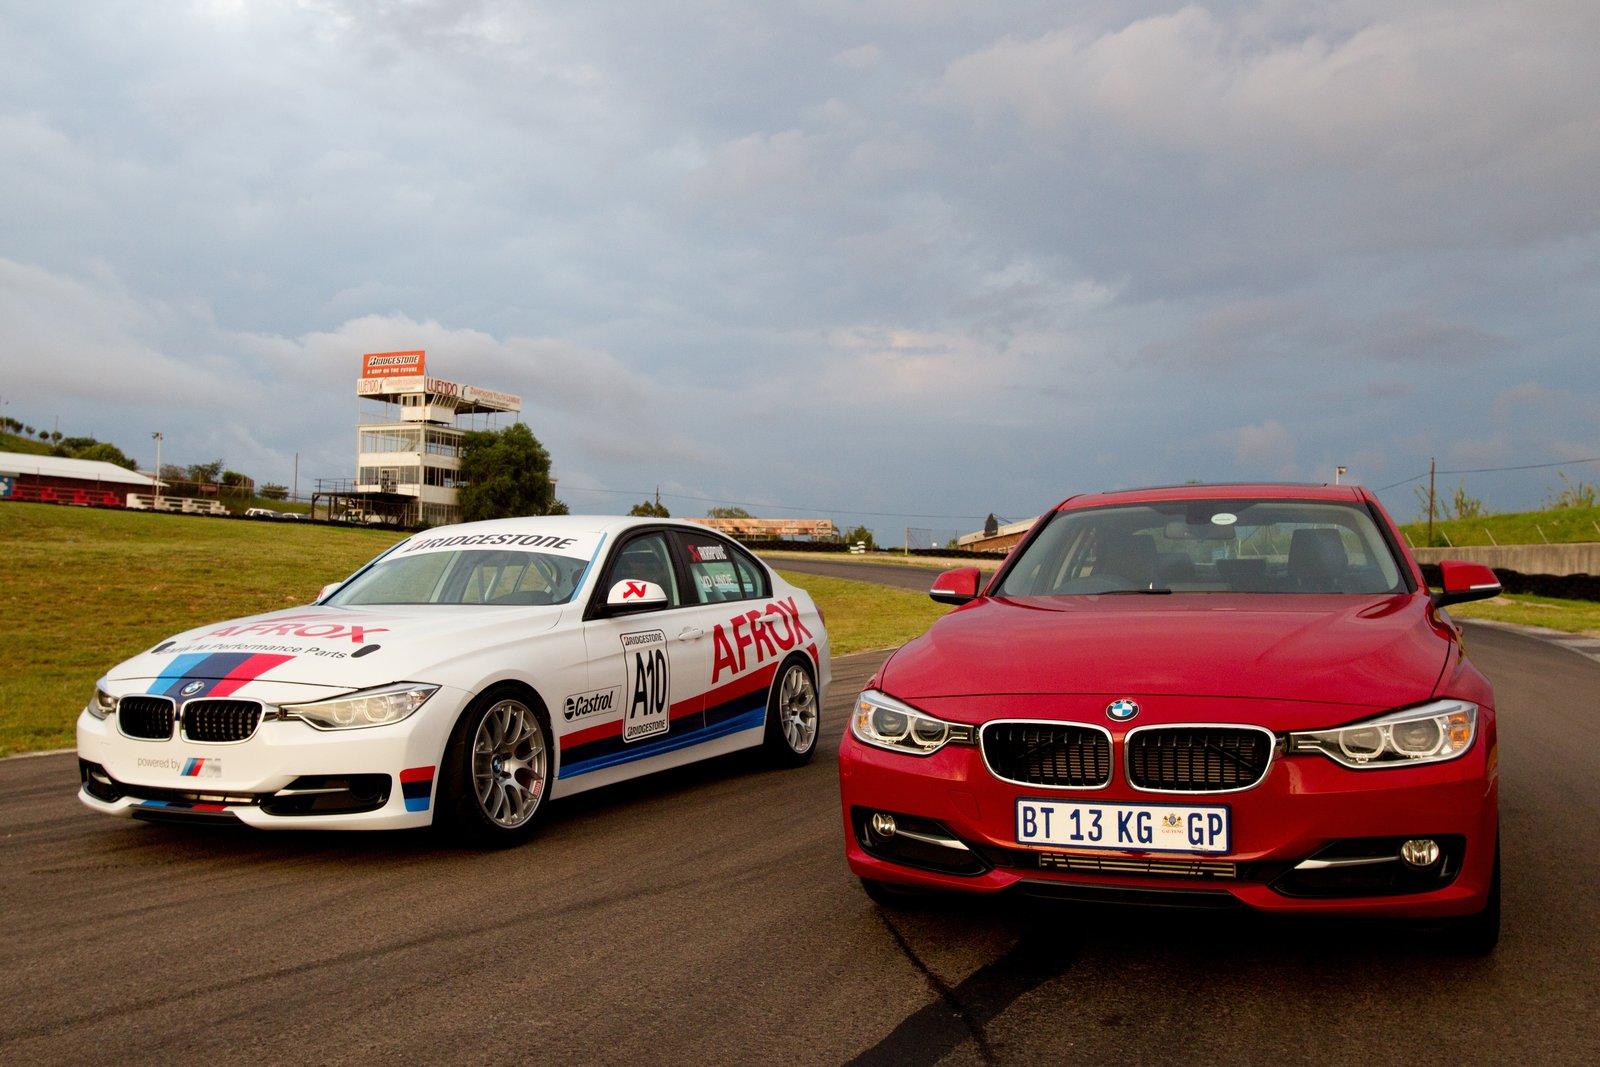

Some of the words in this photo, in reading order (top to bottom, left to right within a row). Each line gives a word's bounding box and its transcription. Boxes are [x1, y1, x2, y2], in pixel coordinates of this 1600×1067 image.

[369, 356, 418, 366] BRIDGESTONE
[408, 534, 578, 551] BRIDGESTONE
[193, 622, 391, 643] AFROX
[624, 633, 663, 646] BRIDGESTONE
[711, 596, 813, 684] AFROX
[304, 645, 347, 659] Parts
[630, 648, 667, 719] A10
[575, 690, 614, 717] Castrol
[627, 720, 666, 737] BRIDGESTONE
[137, 758, 169, 769] powered
[171, 758, 180, 771] by
[1023, 806, 1054, 838] BT
[1070, 809, 1103, 841] 13
[1118, 811, 1153, 844] KG
[1188, 813, 1223, 845] GP
